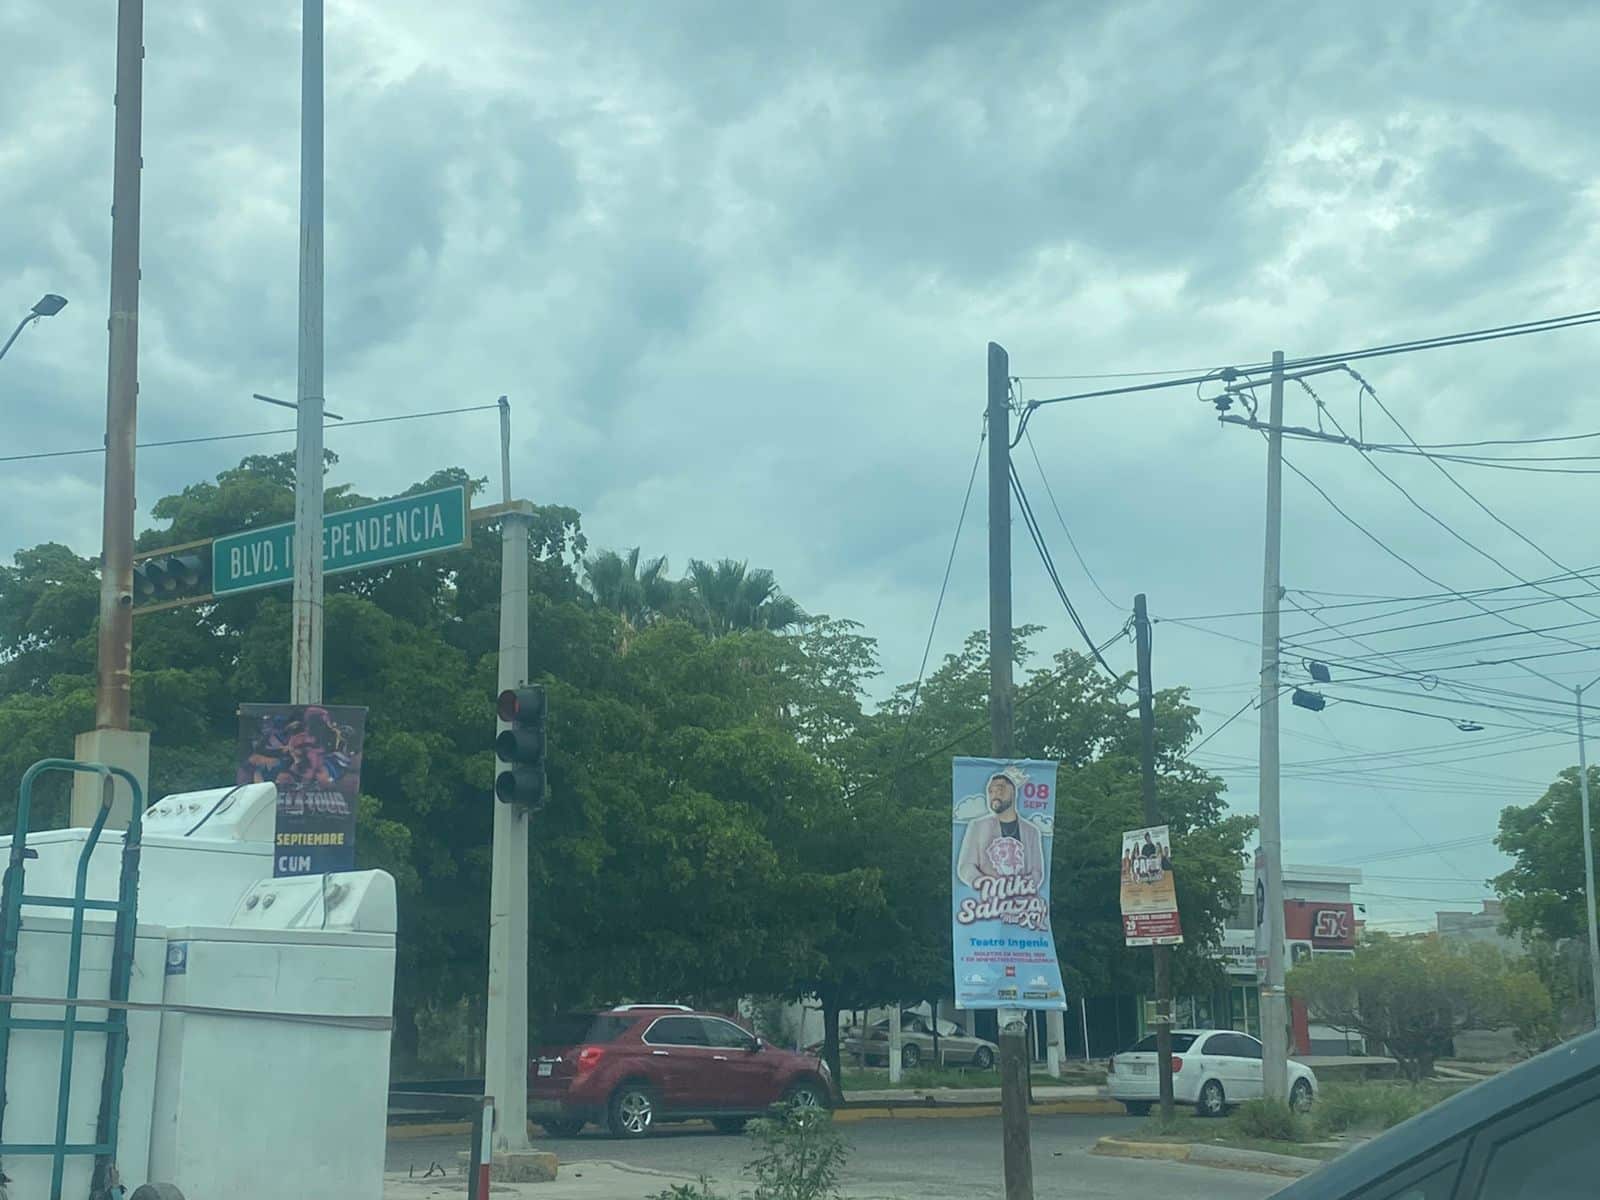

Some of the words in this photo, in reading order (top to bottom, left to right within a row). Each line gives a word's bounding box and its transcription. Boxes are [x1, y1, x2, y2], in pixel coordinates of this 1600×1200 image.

[231, 539, 278, 579] BLVD.
[284, 503, 444, 568] IEPENDENCIA
[1024, 783, 1049, 799] 08
[1023, 800, 1048, 810] SEPT
[276, 833, 345, 846] SEPTIEMBRE
[278, 856, 312, 872] CUM
[973, 875, 1036, 901] Mike
[969, 937, 1006, 947] Teatro
